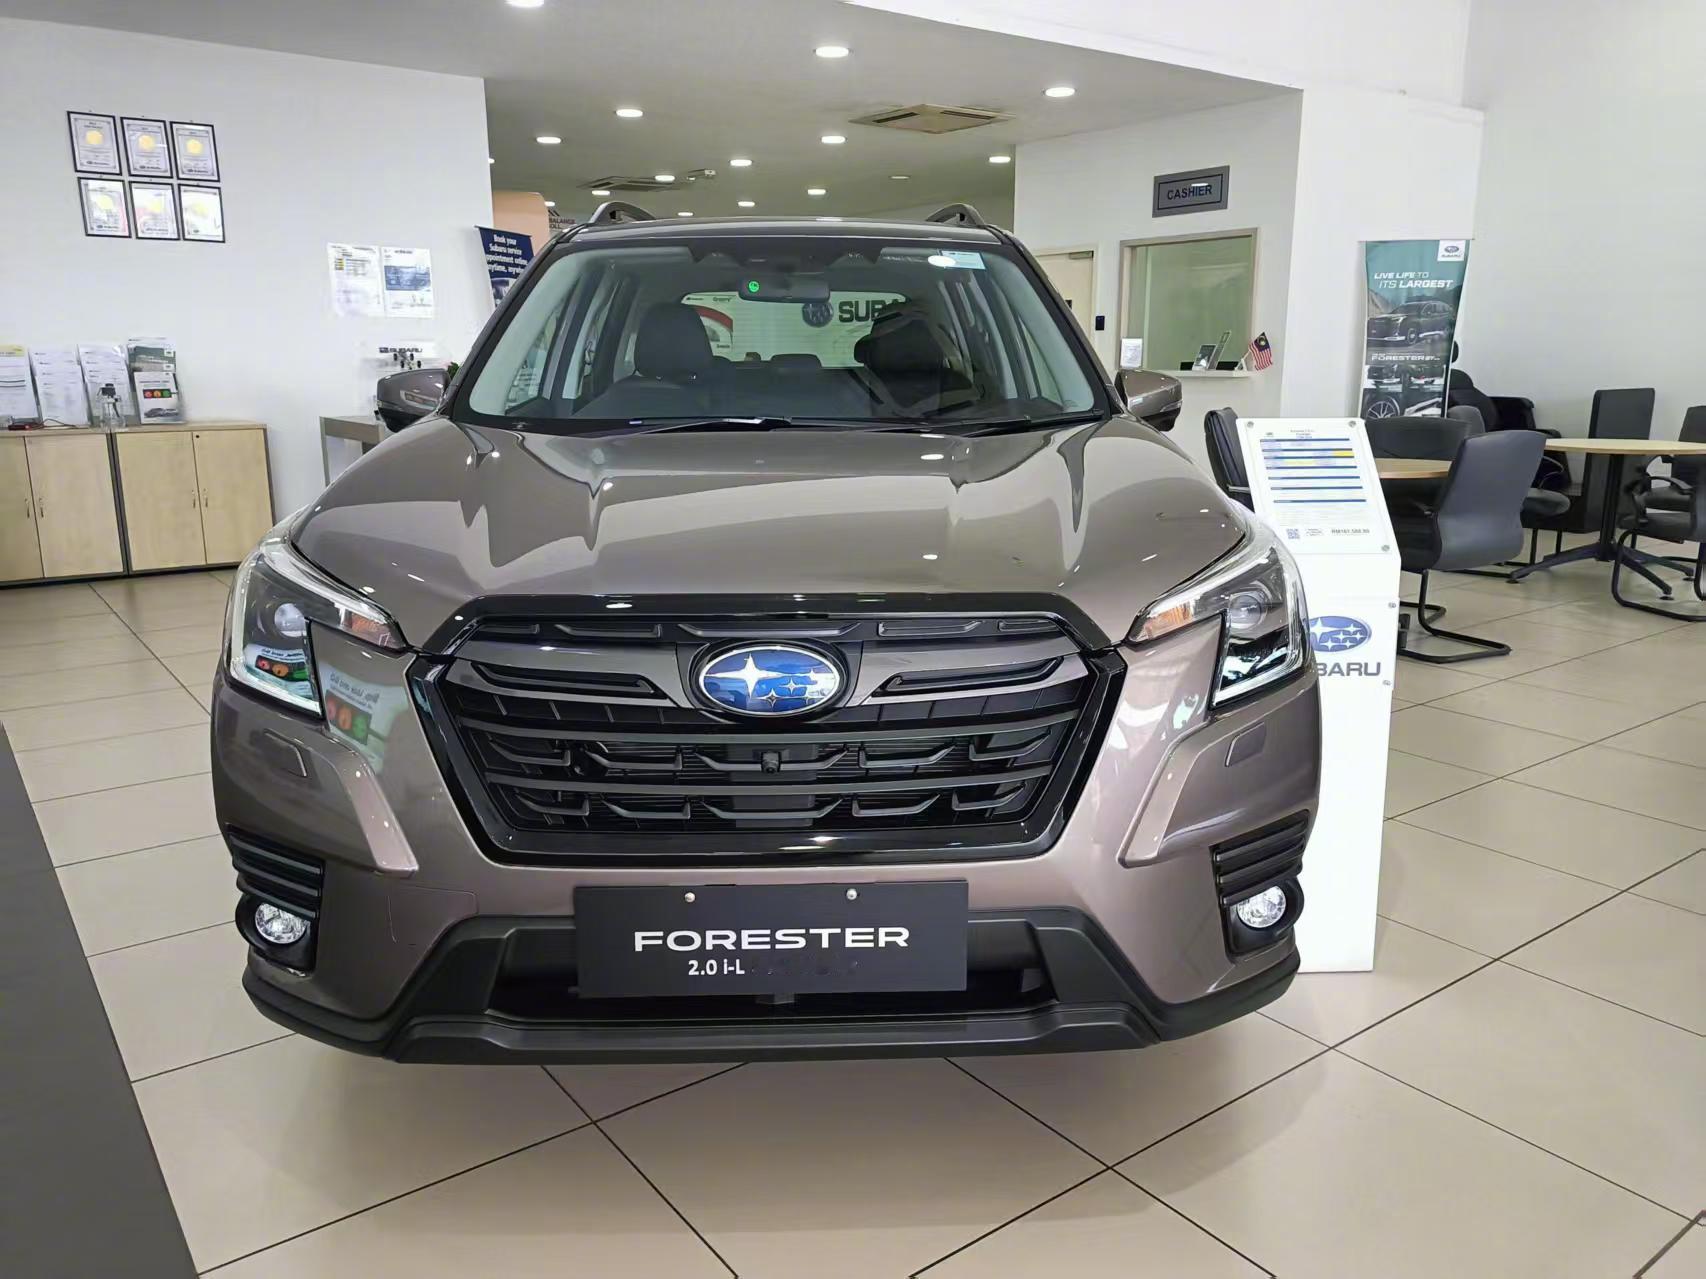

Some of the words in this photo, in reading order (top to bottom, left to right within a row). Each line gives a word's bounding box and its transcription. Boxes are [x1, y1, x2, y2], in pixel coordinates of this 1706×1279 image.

[1167, 184, 1212, 201] CASHIER
[489, 243, 507, 253] Subaru
[1374, 272, 1395, 280] LIVE
[1395, 271, 1416, 279] LIFE
[1417, 271, 1430, 279] TO
[1379, 280, 1398, 288] ITS
[1399, 279, 1454, 288] LARGEST
[634, 926, 910, 952] FORESTER
[688, 959, 717, 976] 2.0
[723, 958, 745, 975] i-L
